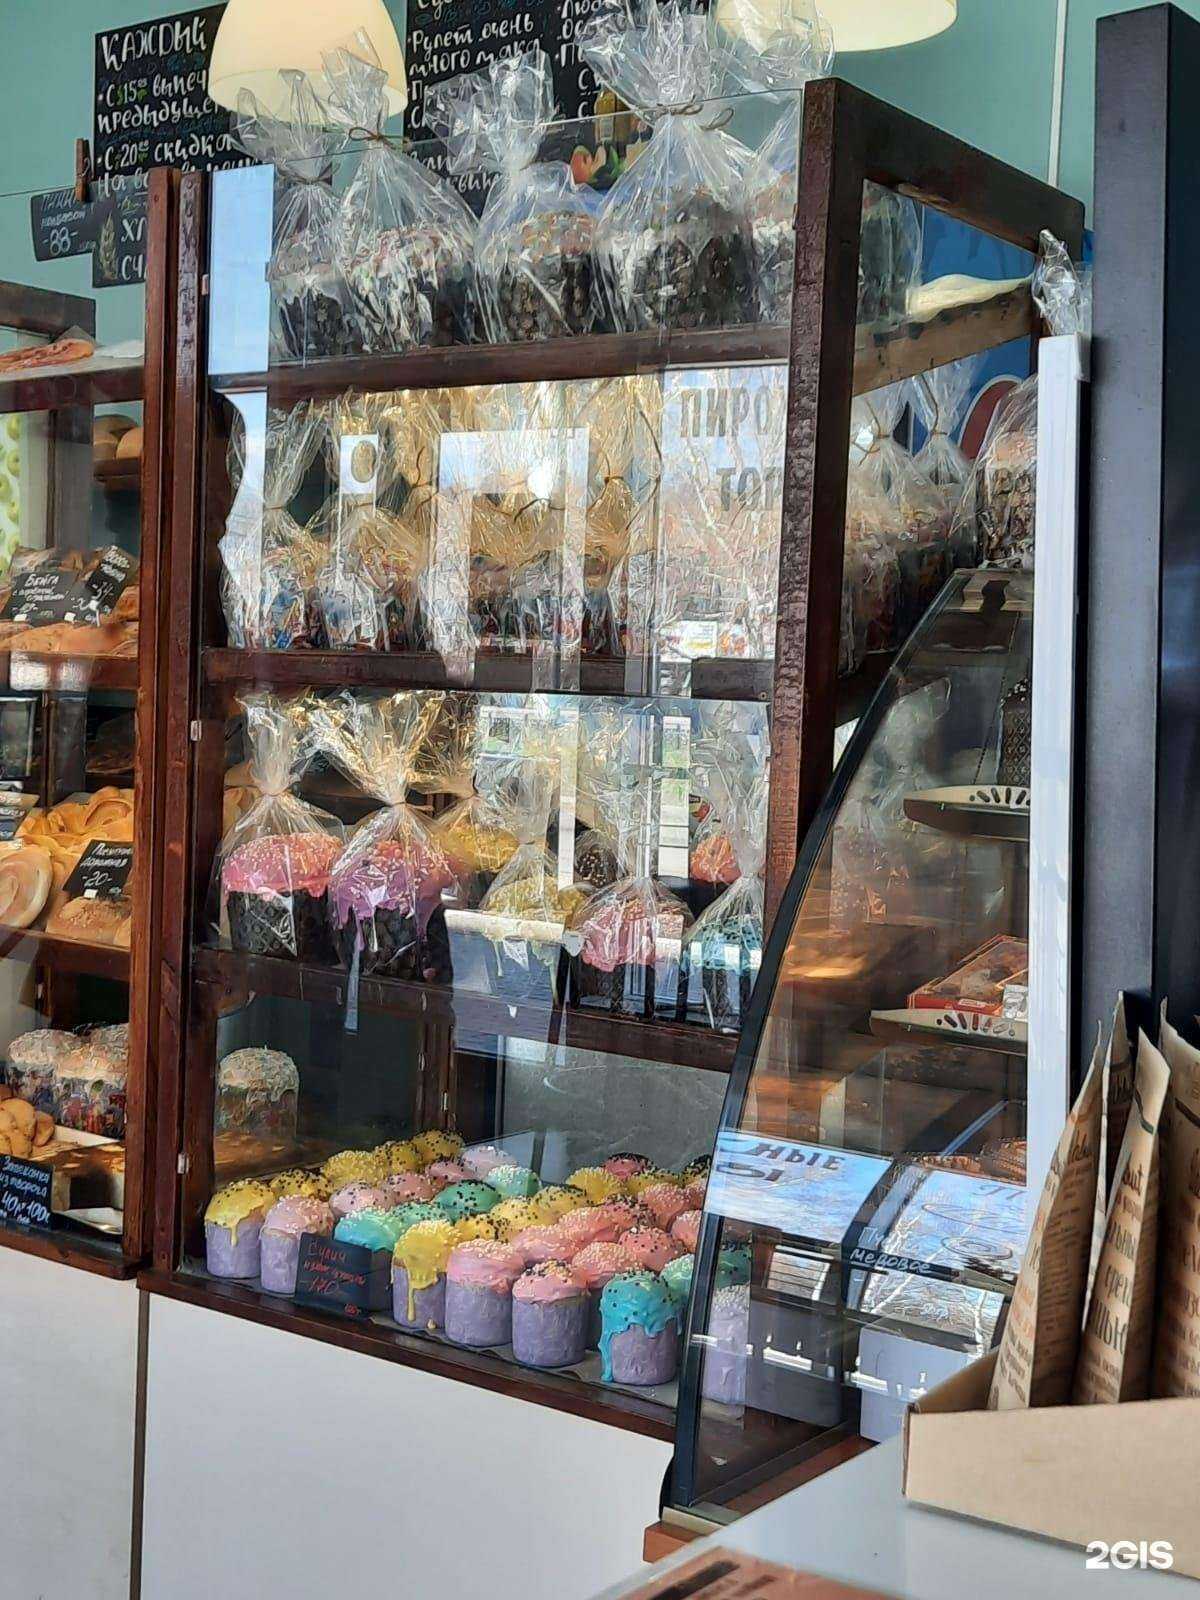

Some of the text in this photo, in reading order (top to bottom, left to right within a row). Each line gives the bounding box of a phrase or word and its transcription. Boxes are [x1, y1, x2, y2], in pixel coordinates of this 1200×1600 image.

[412, 13, 534, 61] Рулет очень
[410, 49, 470, 77] много
[153, 69, 207, 97] выпеч
